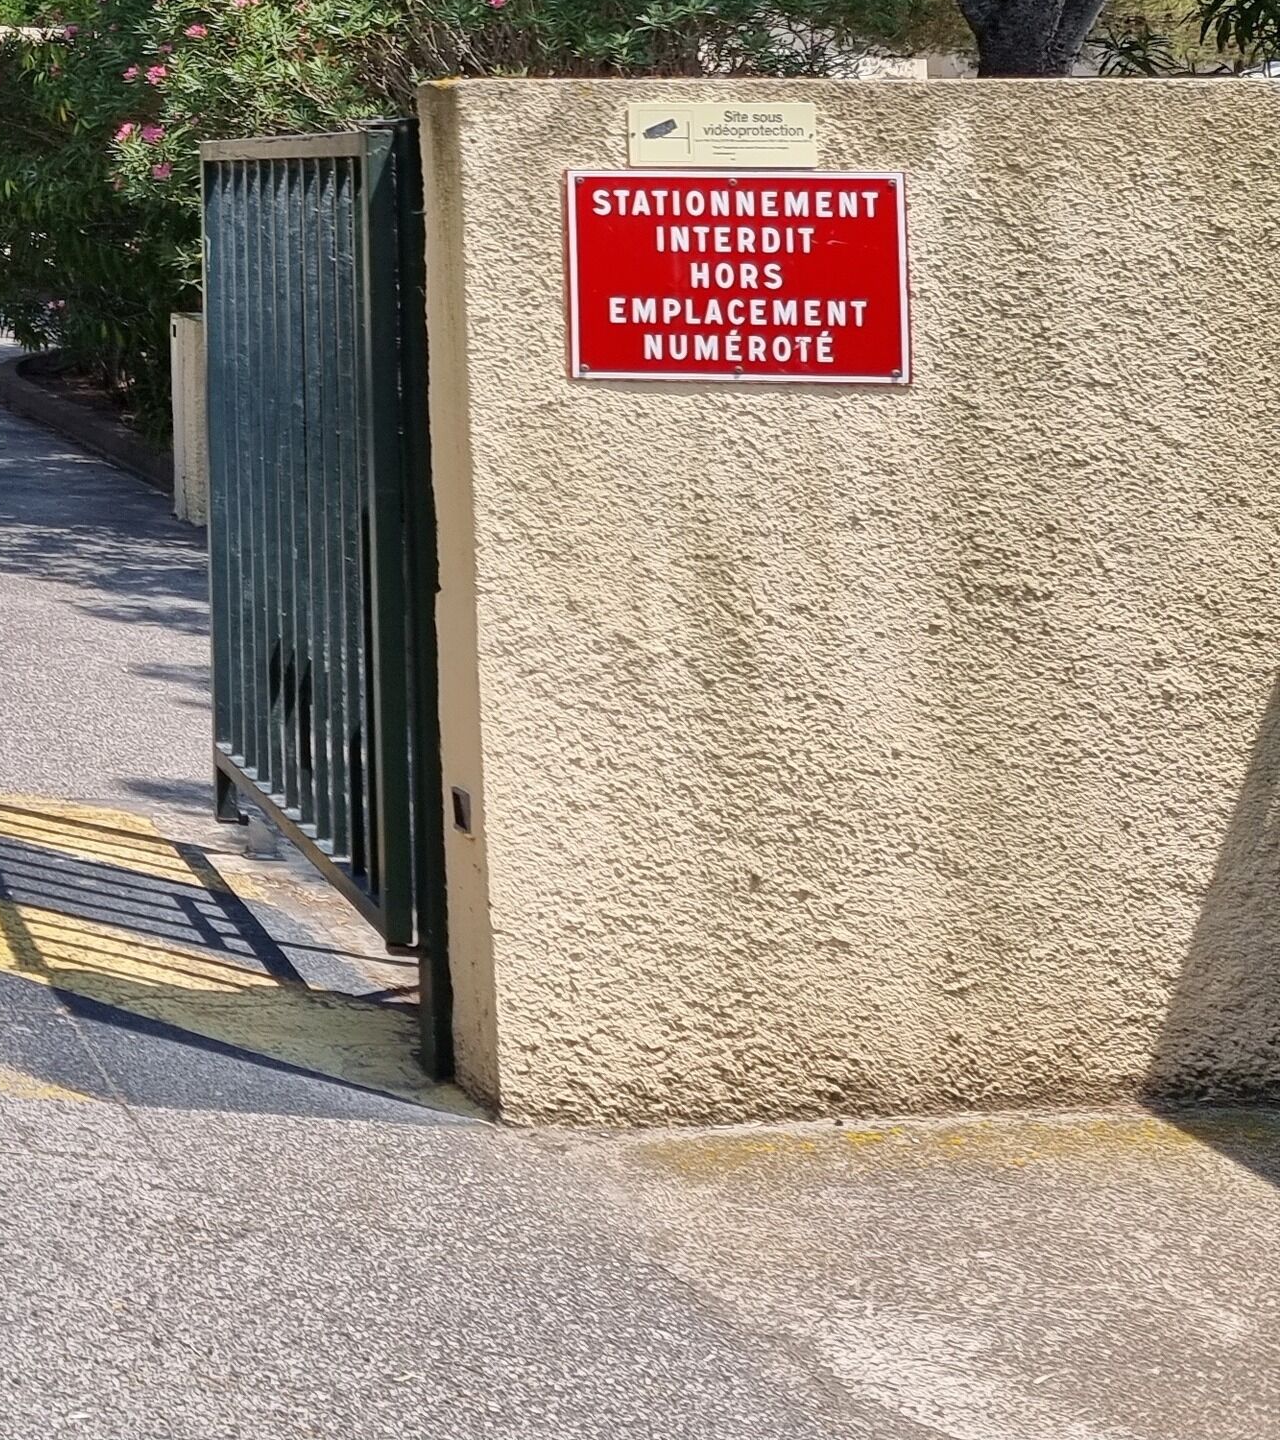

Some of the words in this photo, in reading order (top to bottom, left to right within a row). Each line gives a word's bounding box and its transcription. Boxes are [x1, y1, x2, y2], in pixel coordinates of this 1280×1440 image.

[724, 110, 748, 123] Site
[752, 112, 783, 123] sous
[703, 124, 804, 138] vidéoprotection
[592, 189, 879, 218] STATIONNEMENT
[656, 226, 815, 254] INTERDIT
[690, 262, 783, 290] HORS
[609, 297, 867, 327] EMPLACEMENT
[643, 329, 834, 363] NUMÉROTÉ
